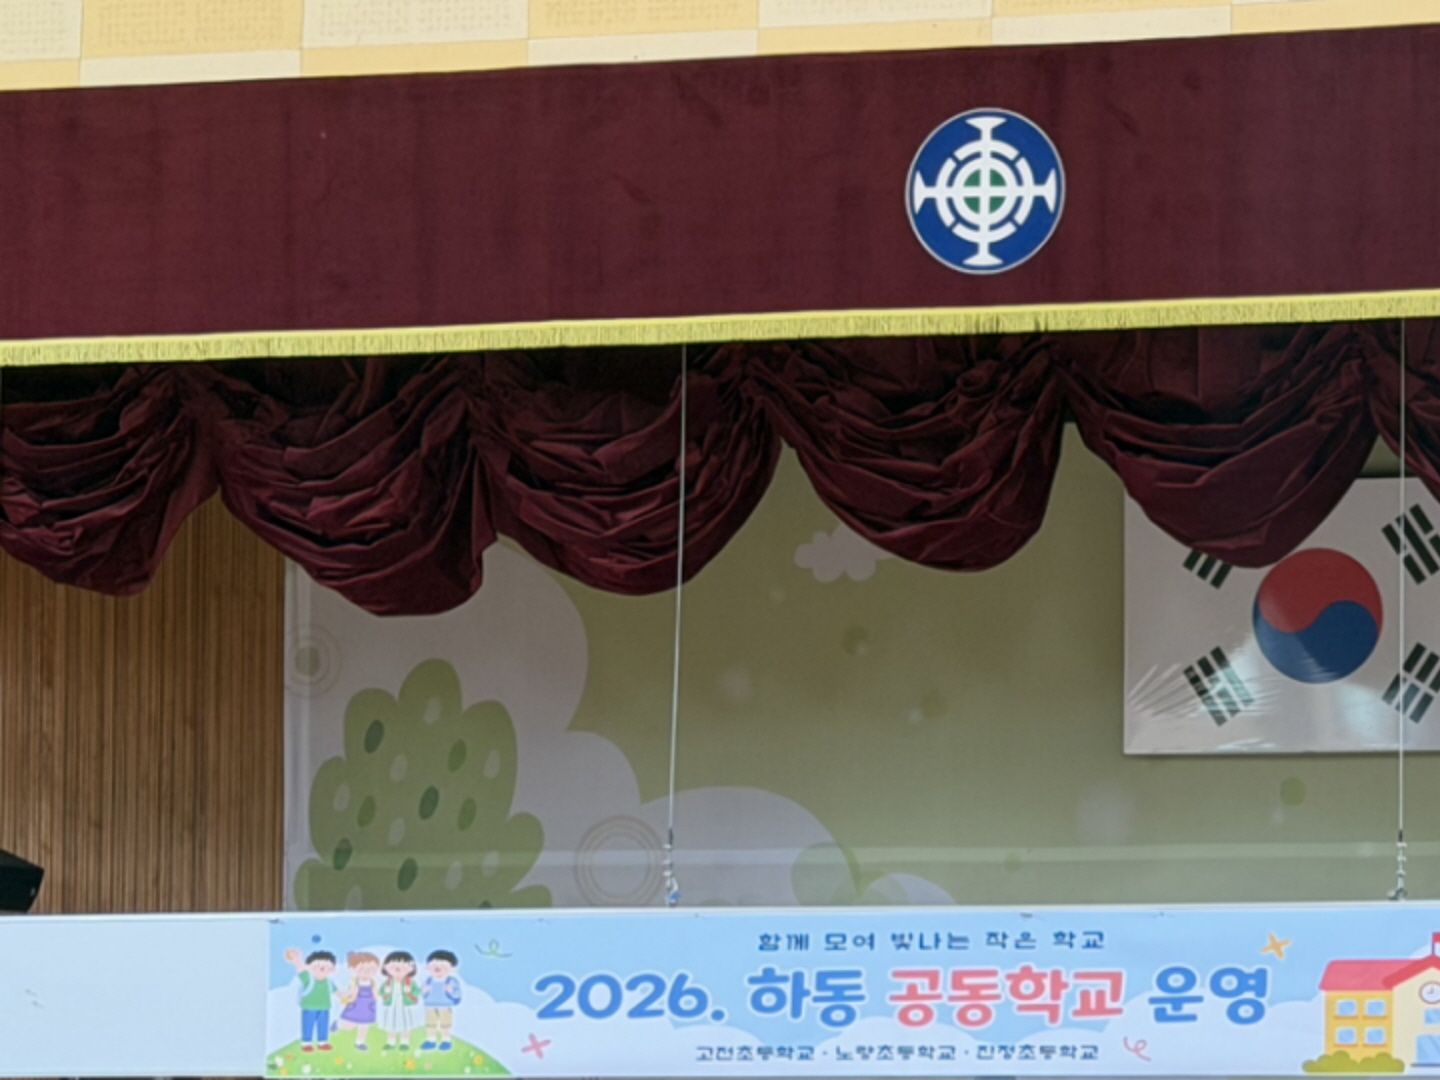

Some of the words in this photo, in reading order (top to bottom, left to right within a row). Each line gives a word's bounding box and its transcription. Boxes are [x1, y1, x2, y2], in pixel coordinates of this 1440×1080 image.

[758, 931, 810, 951] 함께
[824, 931, 876, 951] 모여
[890, 931, 970, 951] 빛나는
[985, 930, 1037, 950] 작은
[1053, 930, 1105, 949] 학교
[534, 973, 725, 1020] 2026.
[747, 966, 866, 1028] 하동
[889, 965, 1124, 1028] 공동학교
[1148, 966, 1268, 1025] 운영
